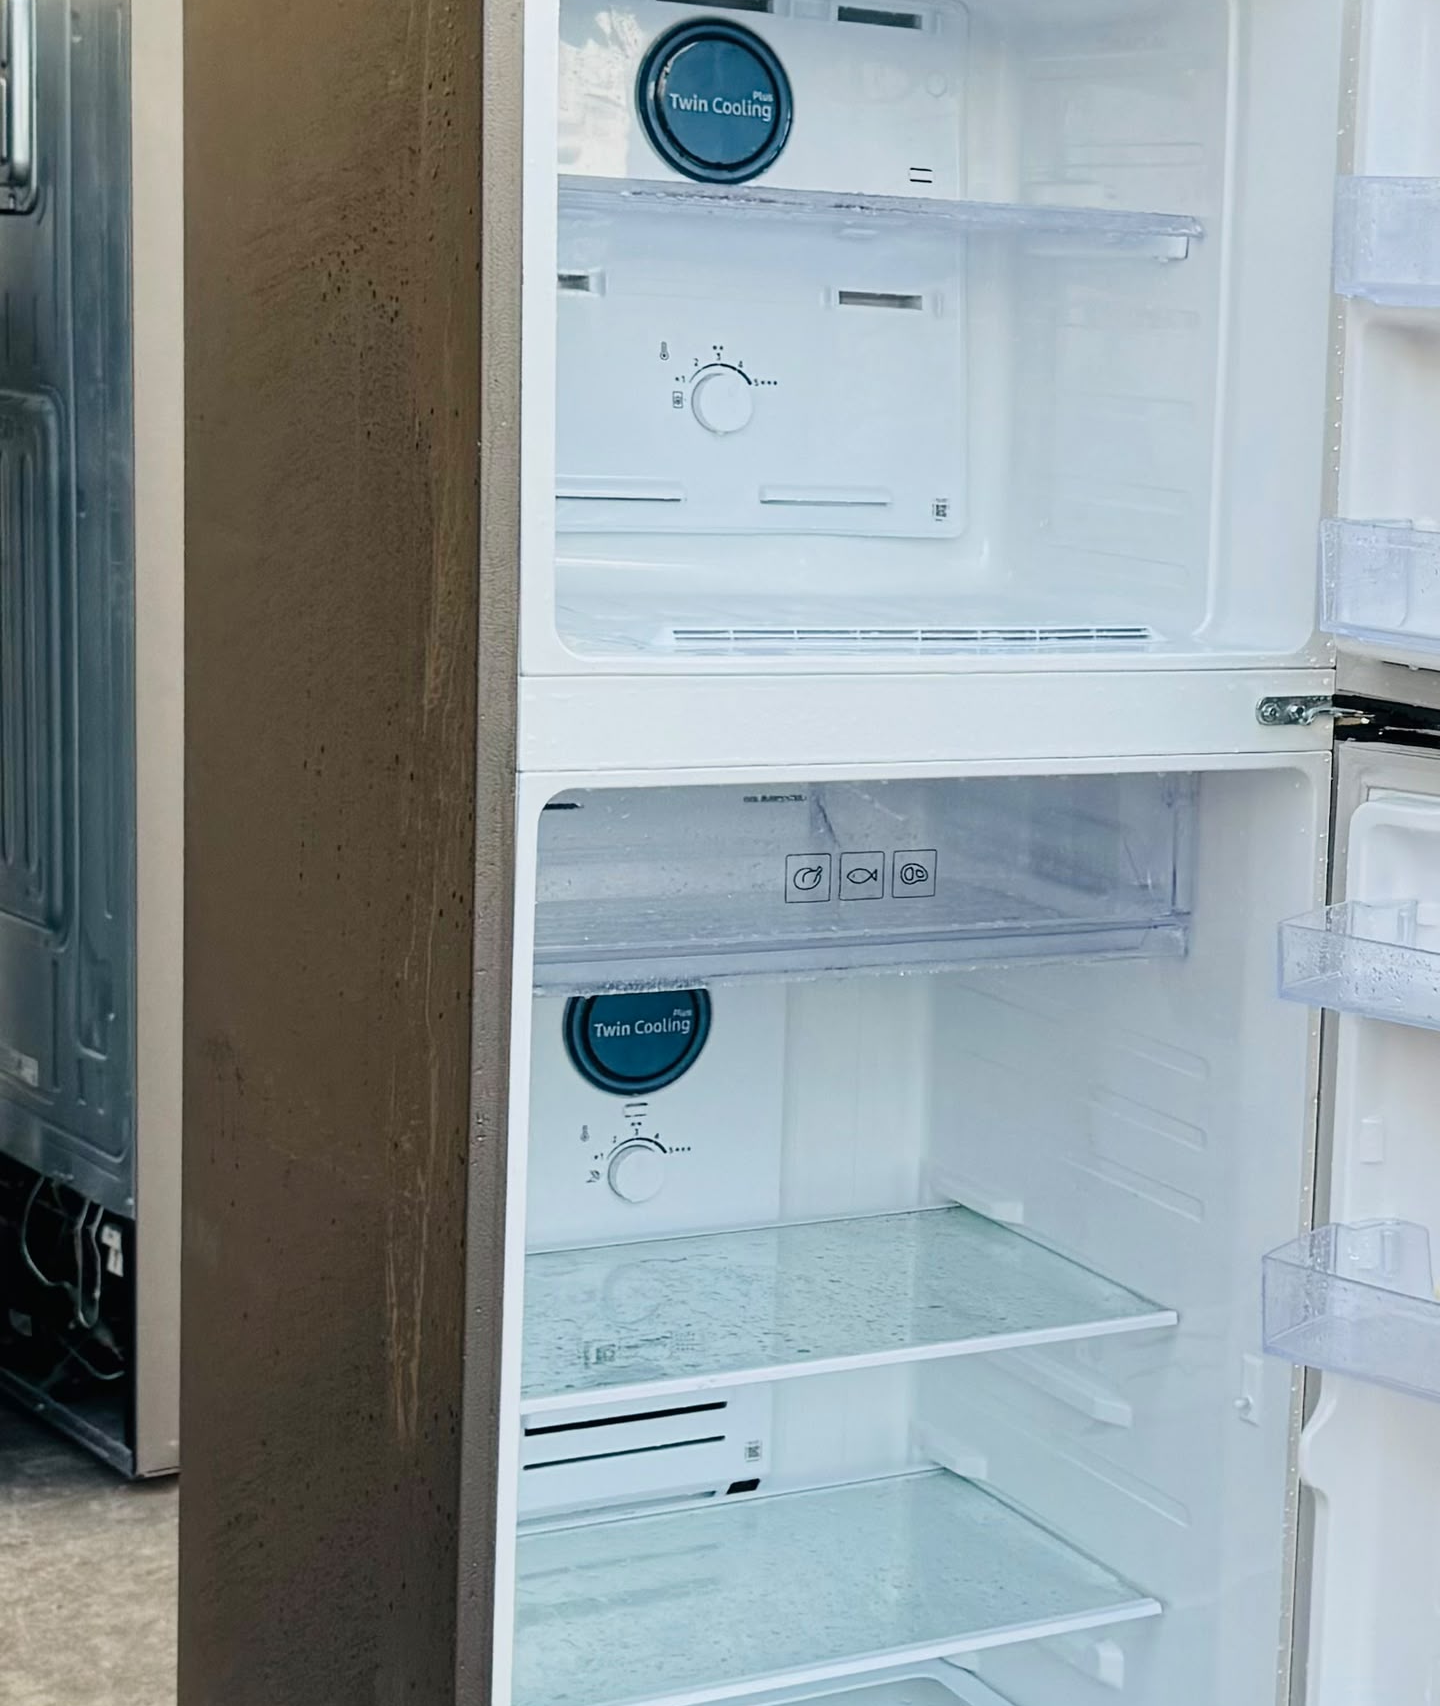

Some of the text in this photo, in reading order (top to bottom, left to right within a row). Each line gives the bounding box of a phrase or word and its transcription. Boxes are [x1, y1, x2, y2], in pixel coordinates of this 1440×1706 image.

[752, 91, 774, 102] Plus
[669, 93, 772, 122] Twin Cooling
[593, 1017, 691, 1038] Twin Cooling
